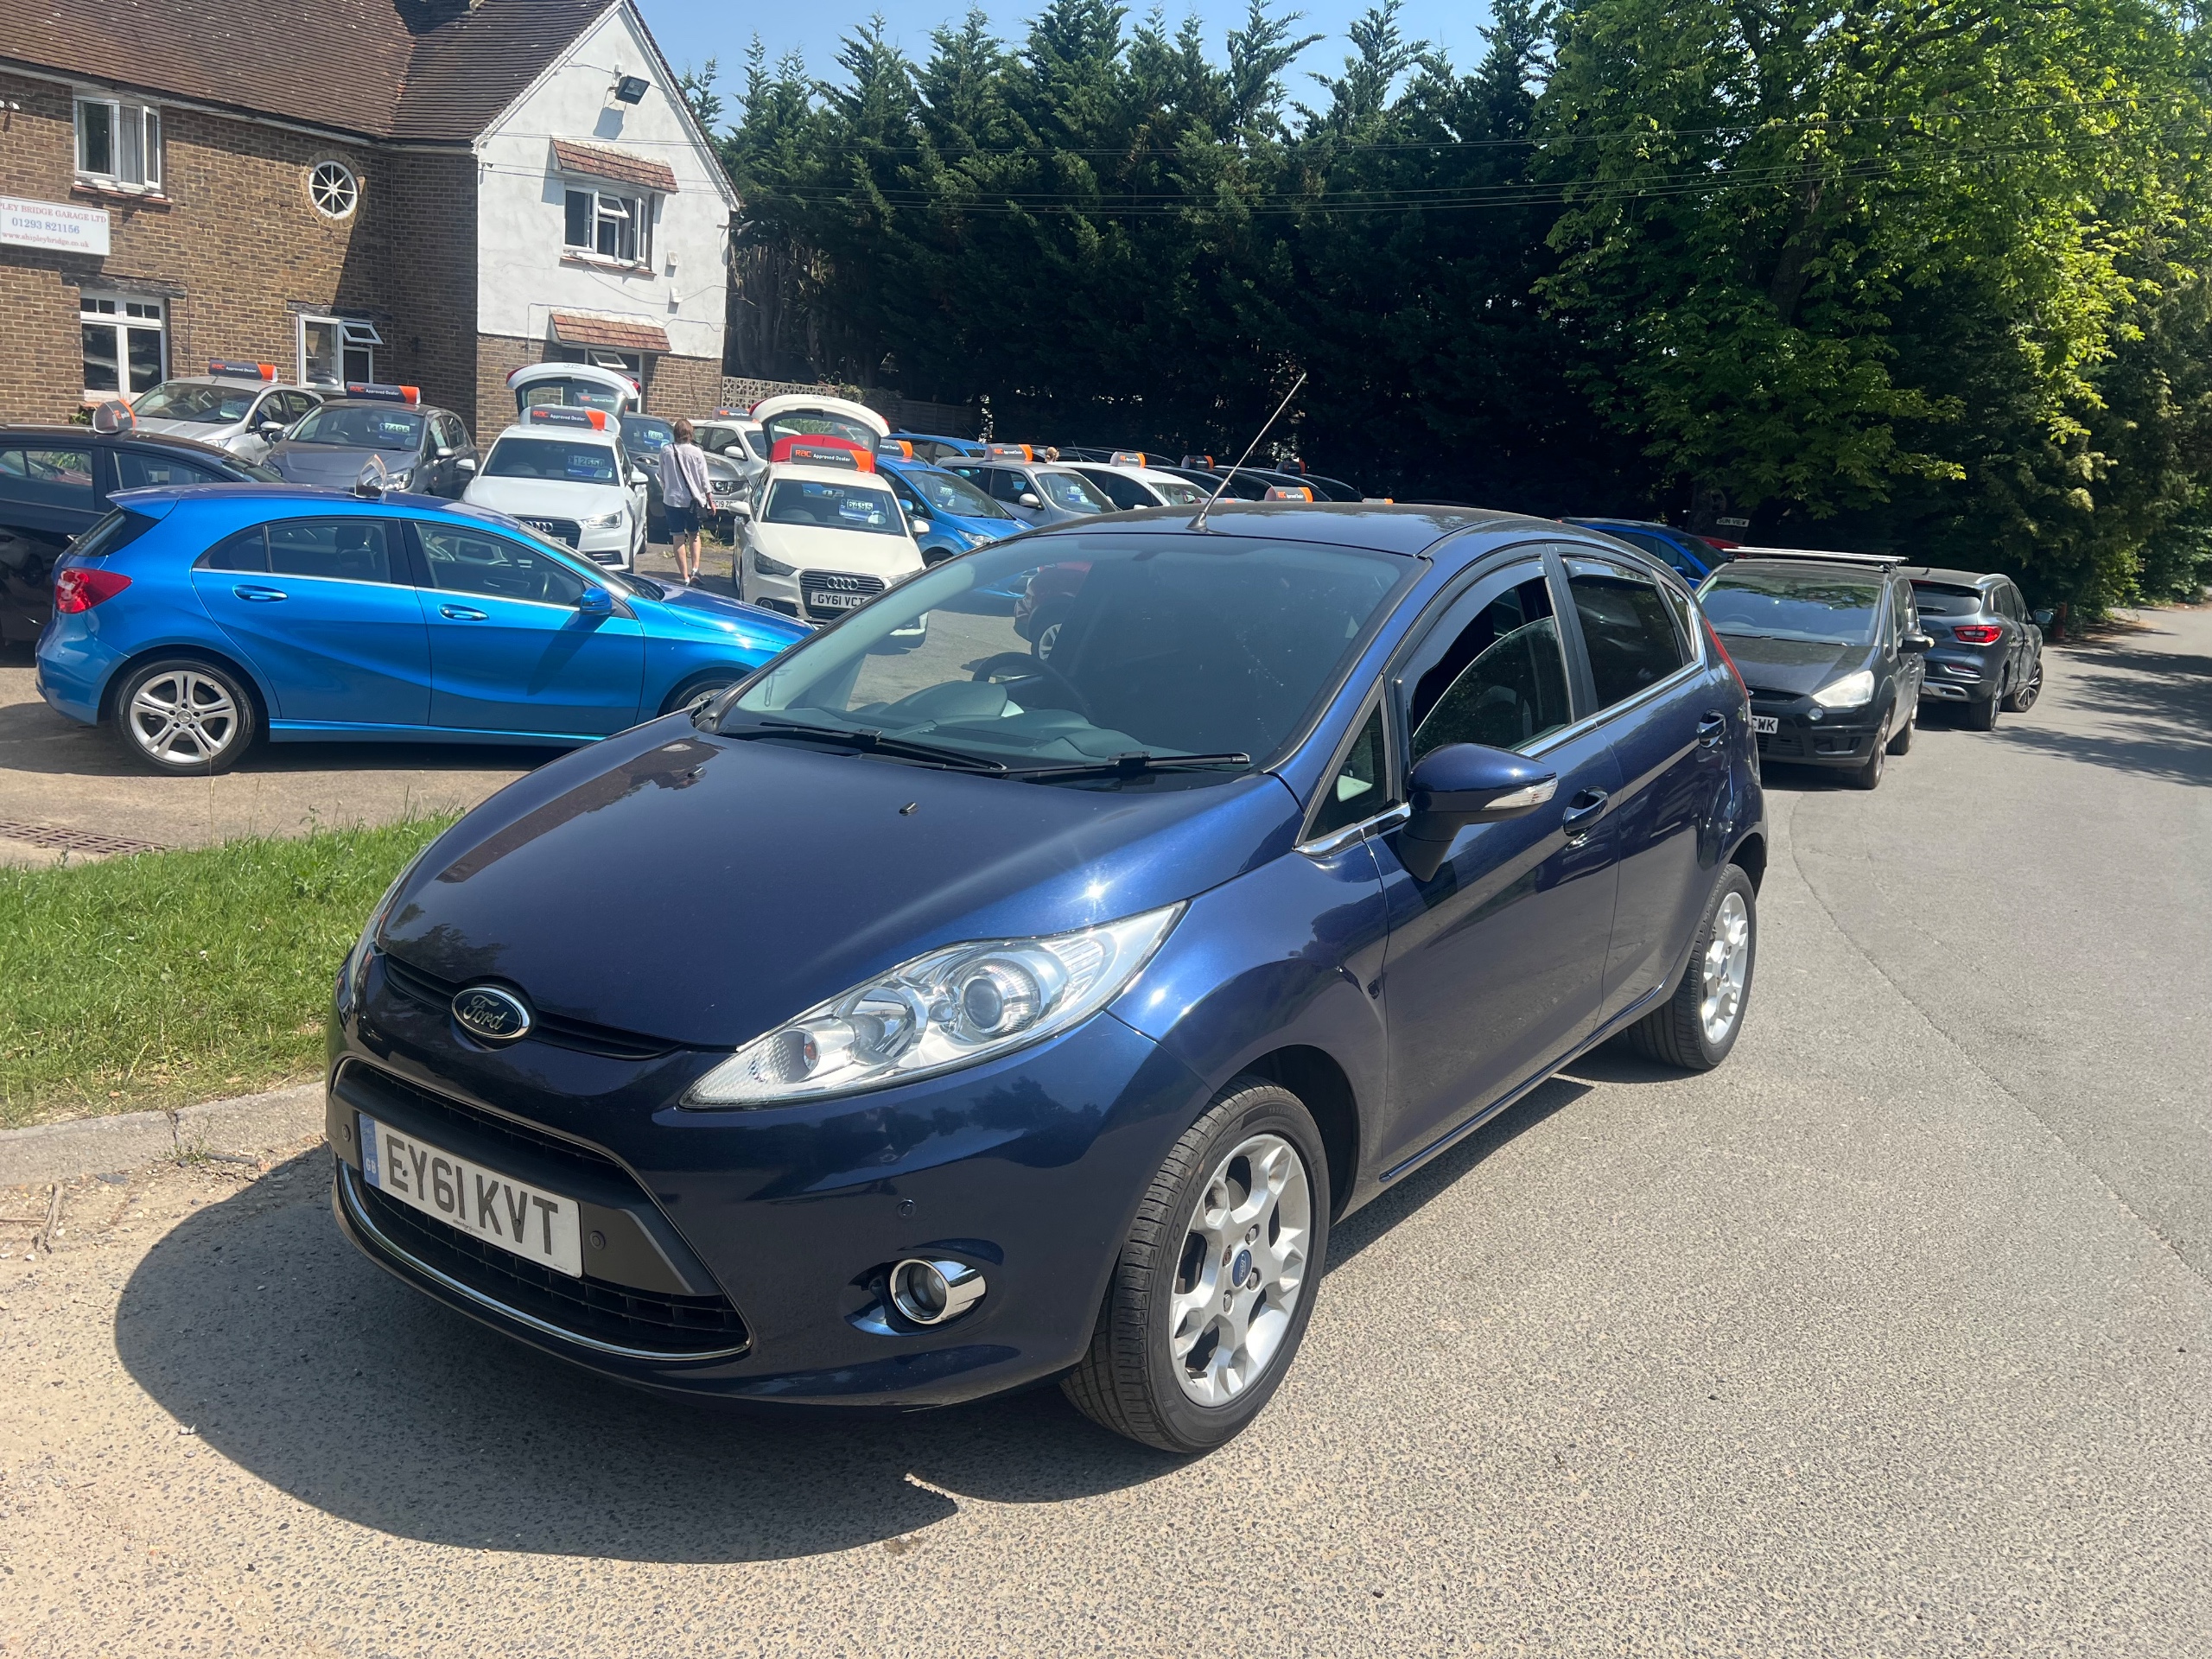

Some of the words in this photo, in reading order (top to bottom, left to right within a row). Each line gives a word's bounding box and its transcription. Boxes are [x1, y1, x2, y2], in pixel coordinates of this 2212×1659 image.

[22, 206, 53, 216] BRIDGE
[55, 210, 89, 221] GARAGE
[91, 214, 107, 223] LTD
[12, 218, 42, 230] 01293
[45, 221, 80, 234] 821156
[2, 232, 90, 248] www.shipleybridge.co.uk
[817, 594, 842, 605] GY61
[845, 596, 865, 607] VCT
[463, 994, 508, 1030] Ford
[365, 1157, 377, 1174] GB
[385, 1134, 467, 1221] EY61
[475, 1173, 559, 1256] KVT
